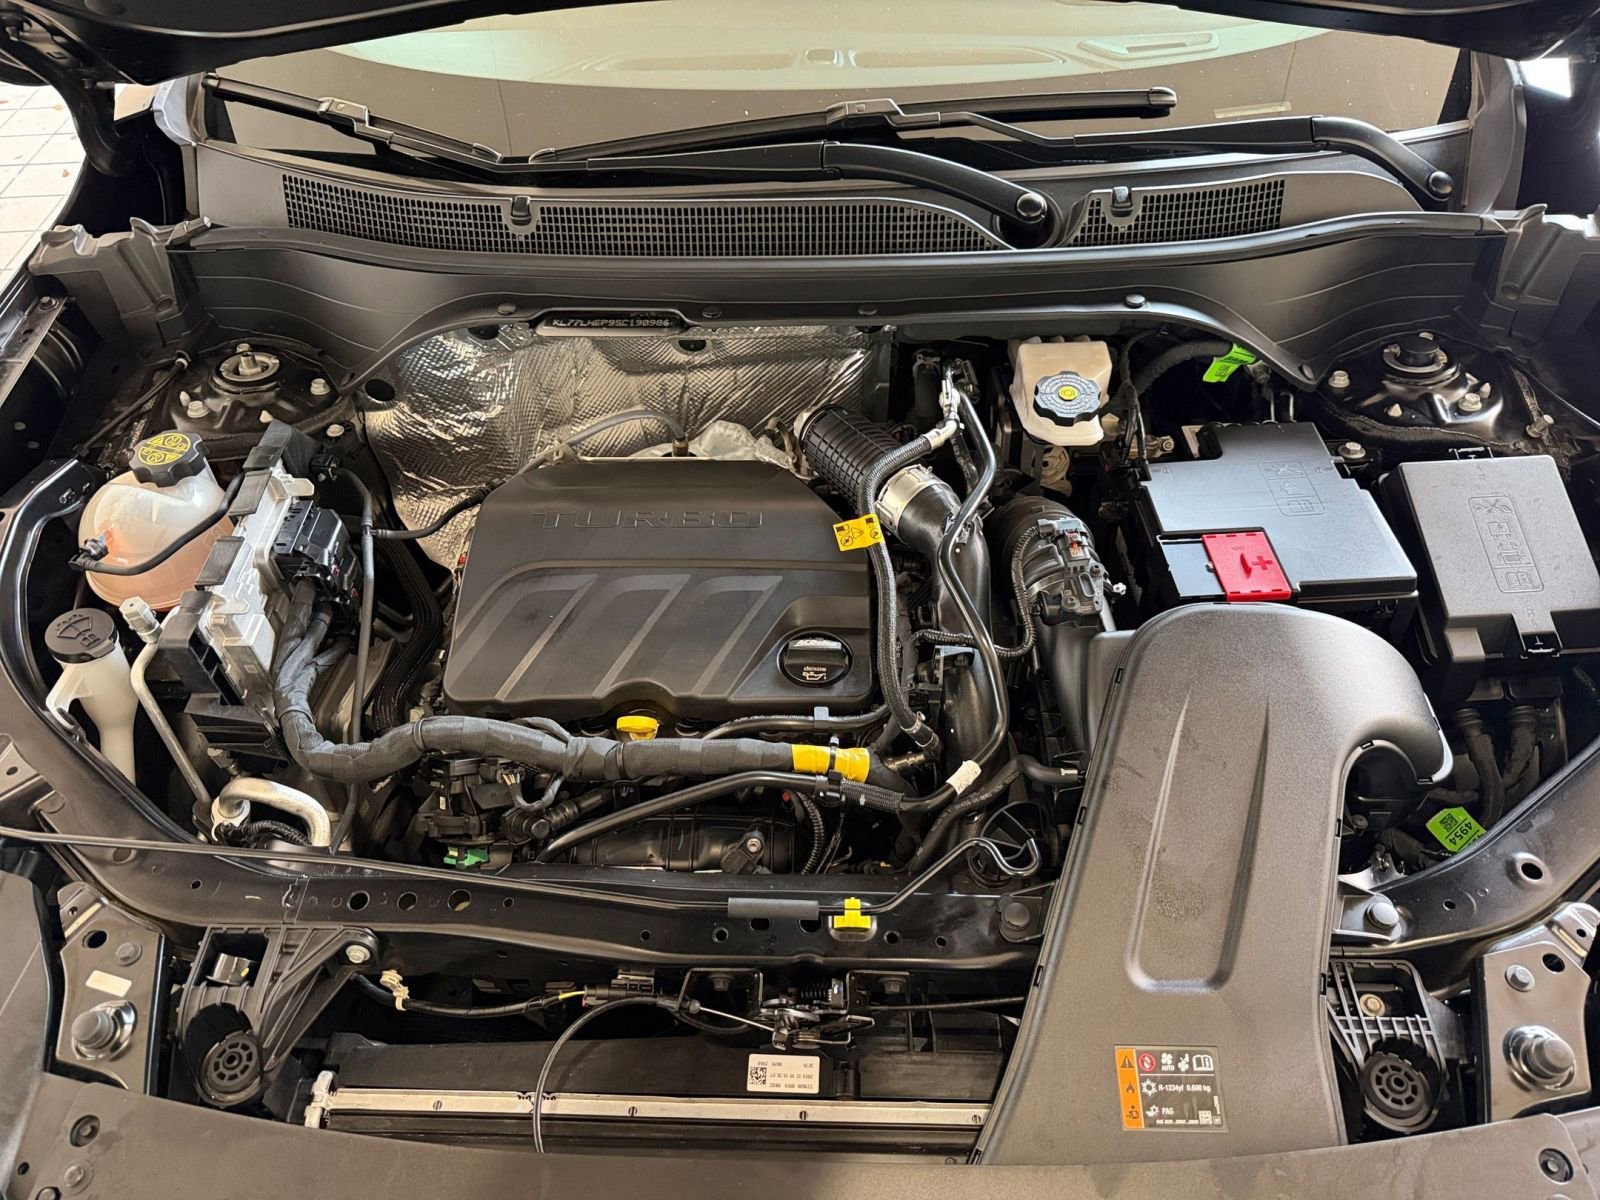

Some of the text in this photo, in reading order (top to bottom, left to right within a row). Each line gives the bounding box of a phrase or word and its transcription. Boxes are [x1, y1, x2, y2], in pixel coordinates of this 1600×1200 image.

[532, 511, 764, 529] TURBO
[1449, 822, 1472, 846] 4954
[1203, 1085, 1211, 1093] kg
[1161, 1107, 1174, 1115] PAG
